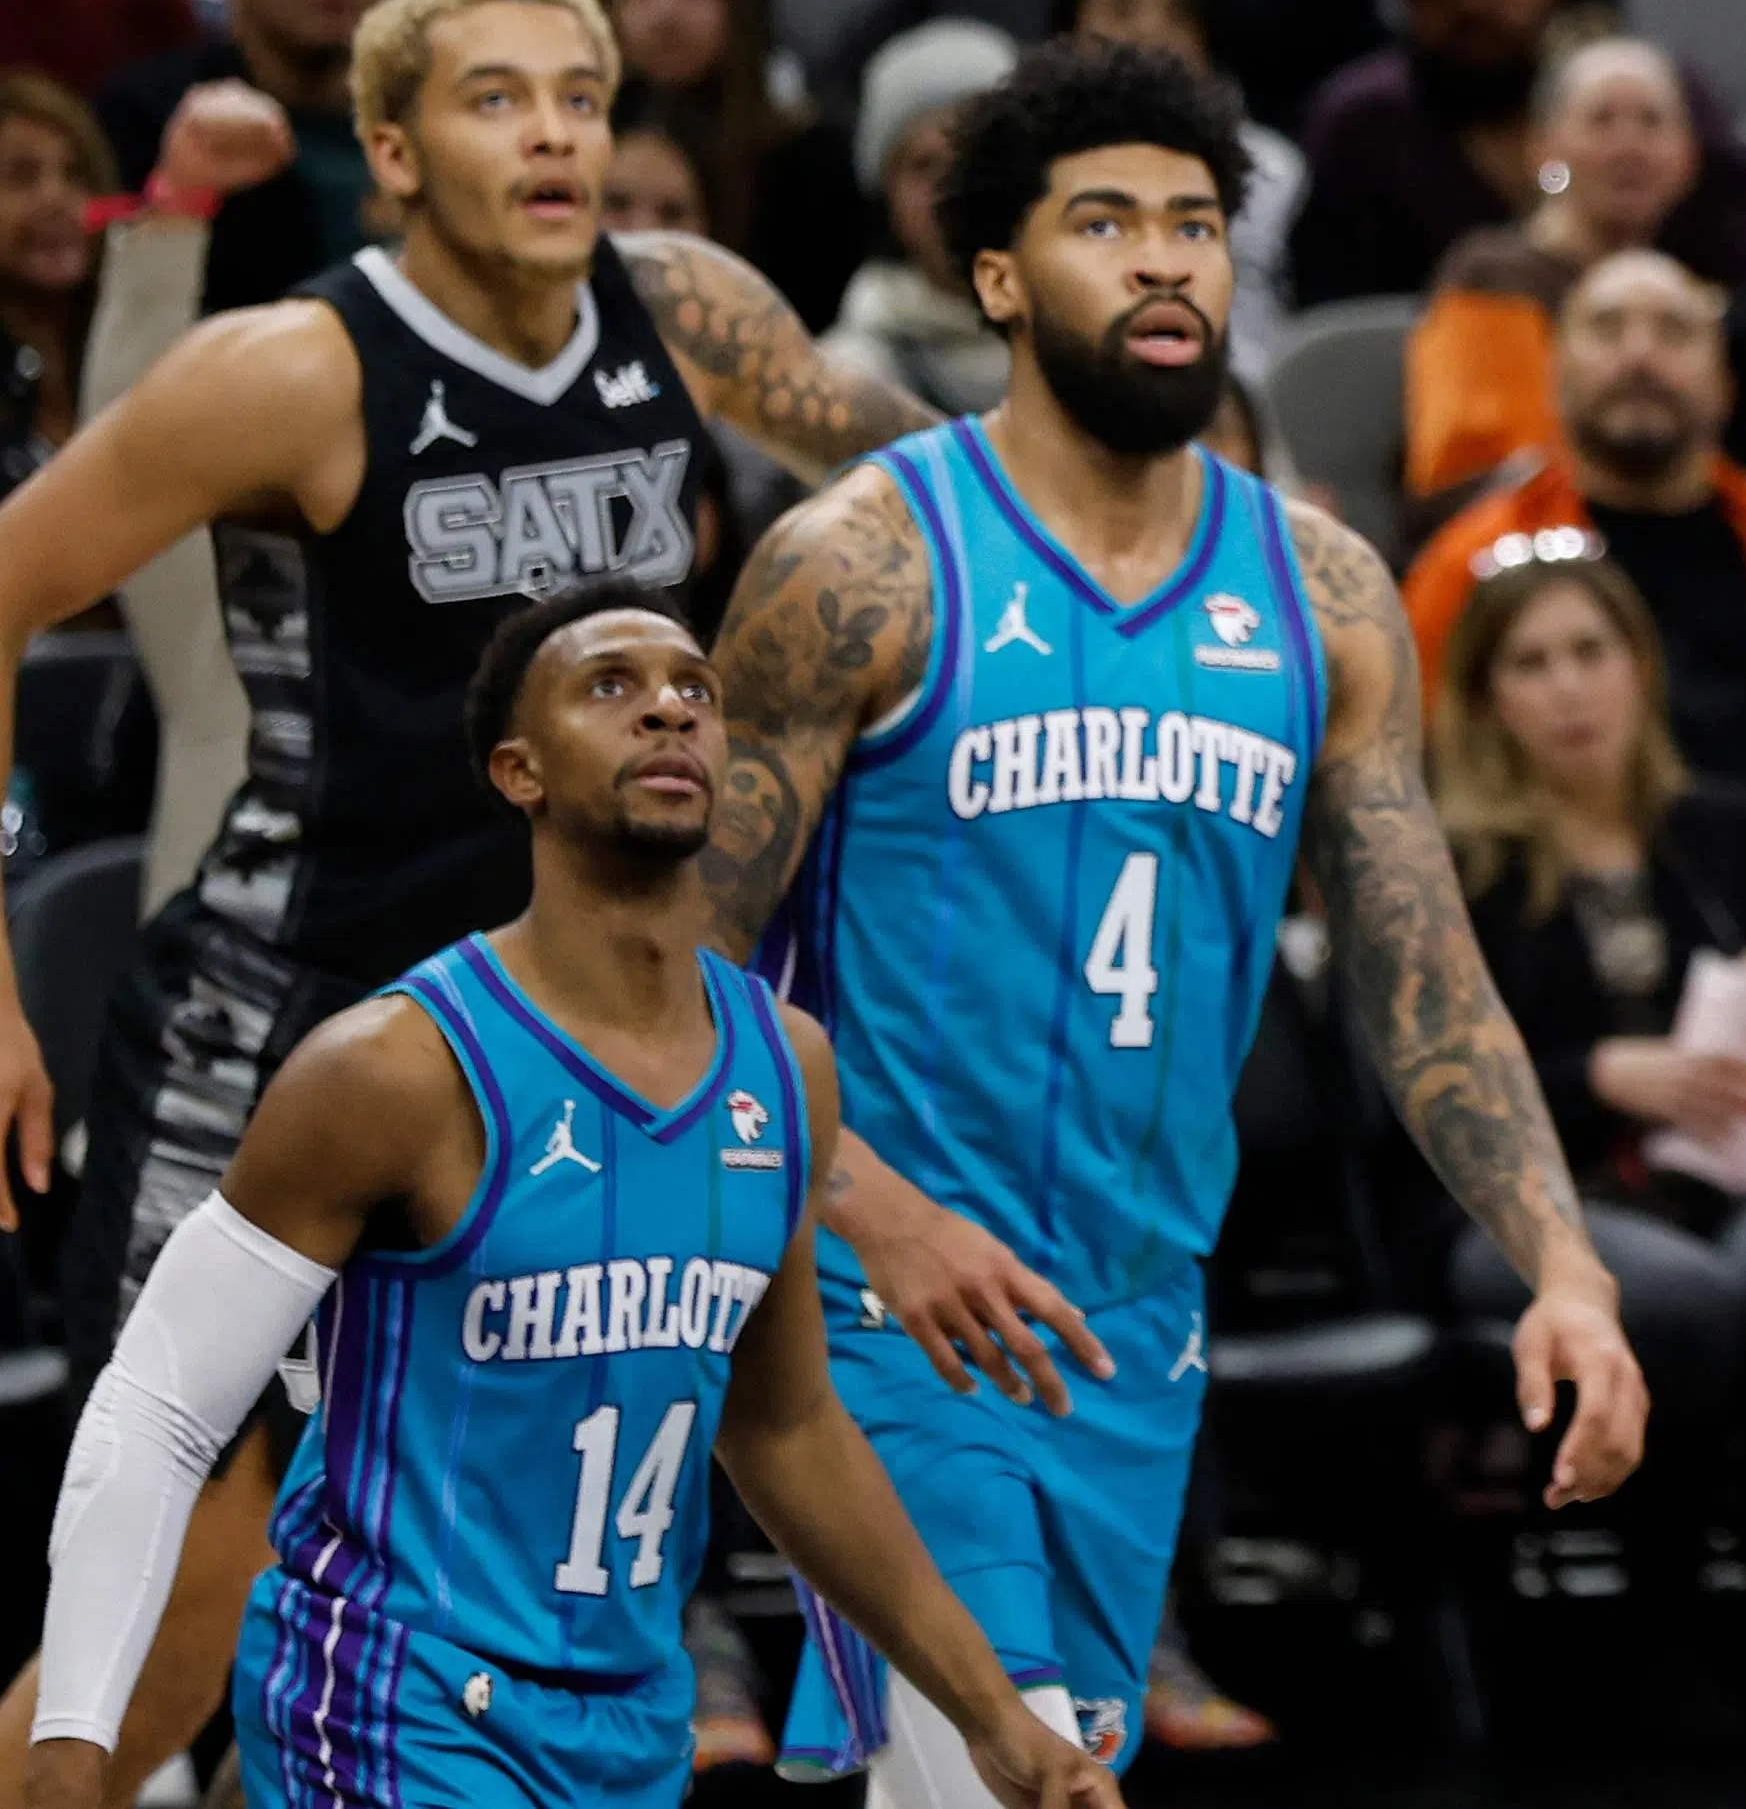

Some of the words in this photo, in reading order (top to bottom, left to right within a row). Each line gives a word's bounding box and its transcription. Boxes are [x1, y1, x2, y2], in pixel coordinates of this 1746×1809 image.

[402, 438, 694, 604] SATX
[948, 705, 1297, 839] CHARLOTTE
[1083, 850, 1159, 1049] 4
[461, 1254, 772, 1363] CHARLOTT
[553, 1399, 697, 1596] 14
